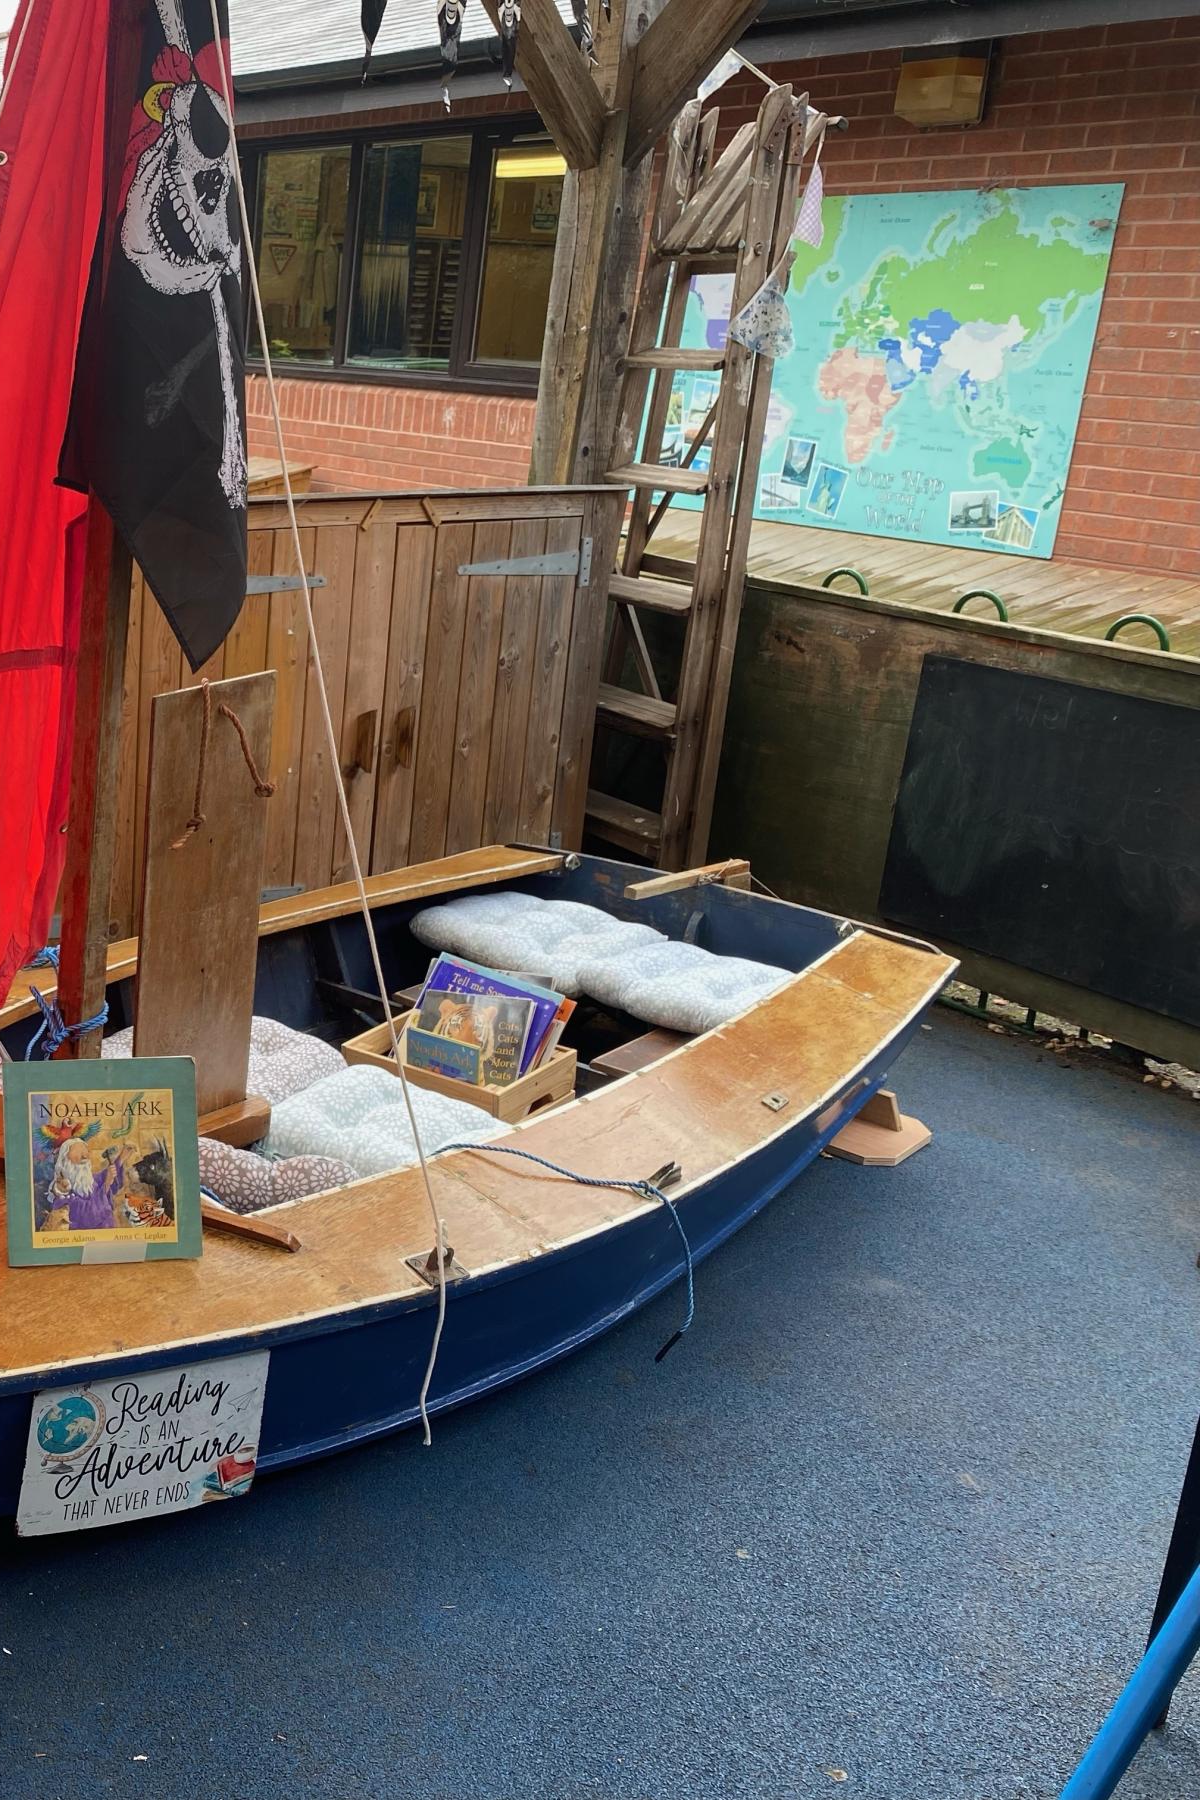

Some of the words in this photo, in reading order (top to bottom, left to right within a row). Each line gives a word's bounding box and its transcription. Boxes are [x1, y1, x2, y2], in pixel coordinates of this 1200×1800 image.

[902, 470, 945, 500] Map
[864, 505, 927, 533] World
[452, 972, 470, 987] Tell
[470, 982, 485, 993] me
[497, 1033, 519, 1044] Cats
[494, 1047, 515, 1056] and
[491, 1057, 516, 1069] More
[489, 1070, 511, 1080] Cats
[39, 1101, 115, 1118] NOAH'S
[122, 1101, 162, 1117] ARK
[113, 1233, 133, 1241] Anna
[105, 1372, 230, 1434] Reading
[138, 1424, 150, 1446] IS
[158, 1419, 180, 1441] AN
[54, 1432, 245, 1500] Adventure
[63, 1499, 97, 1521] THAT
[103, 1489, 149, 1515] NEVER
[156, 1480, 191, 1506] ENDS
